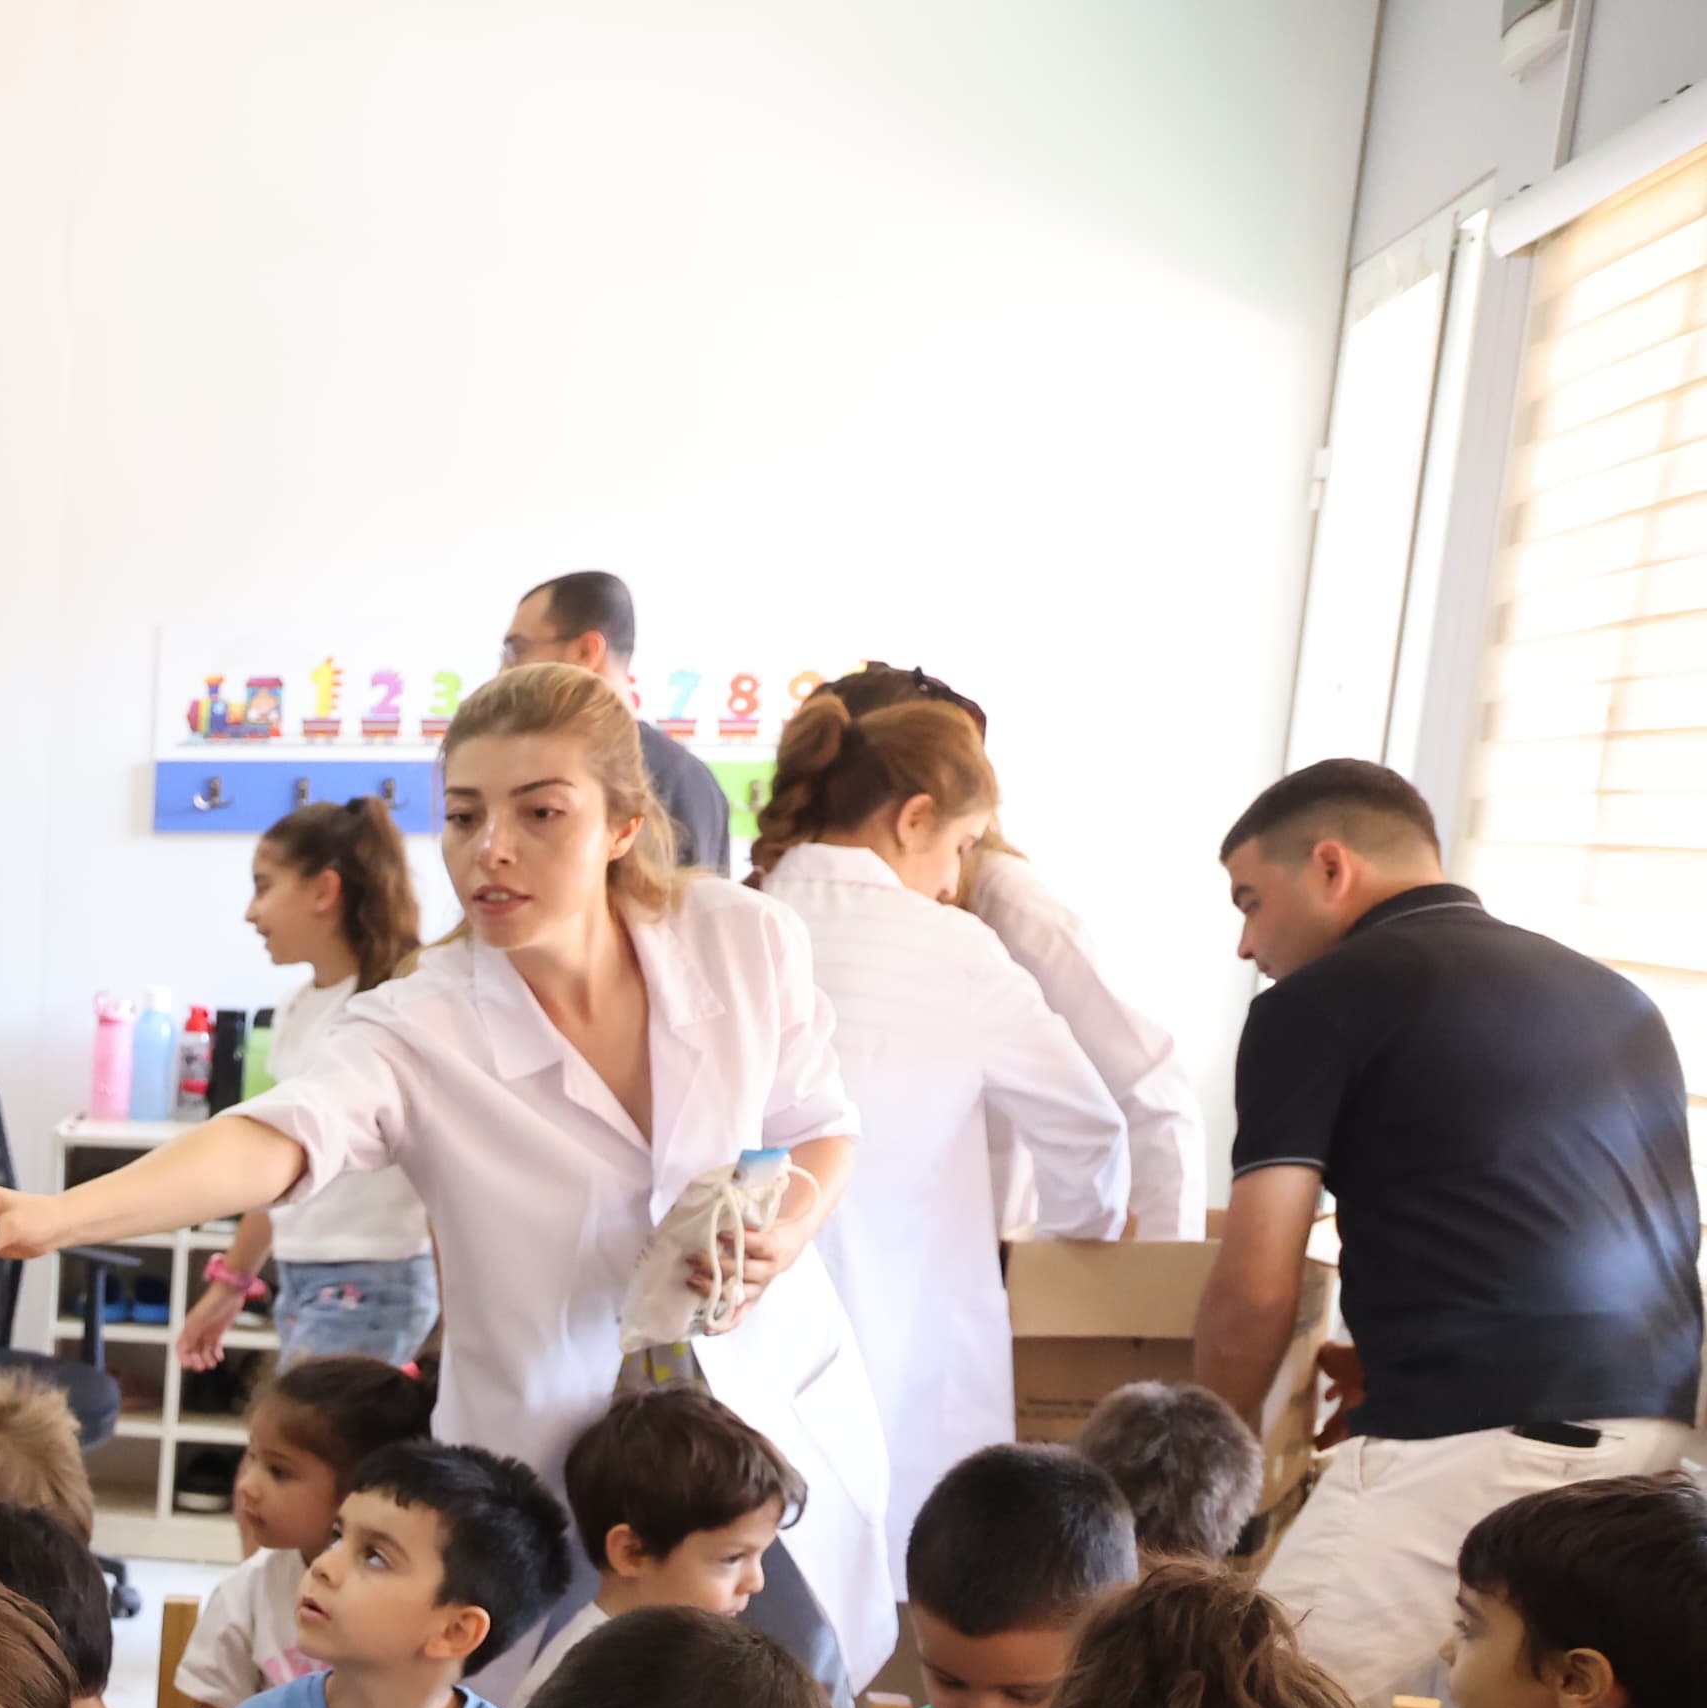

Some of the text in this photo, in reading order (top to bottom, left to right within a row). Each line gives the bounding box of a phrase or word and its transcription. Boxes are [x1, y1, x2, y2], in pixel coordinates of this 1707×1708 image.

[370, 670, 404, 715] 2
[430, 671, 462, 716] 3
[667, 668, 700, 718] 7
[728, 673, 760, 717] 8
